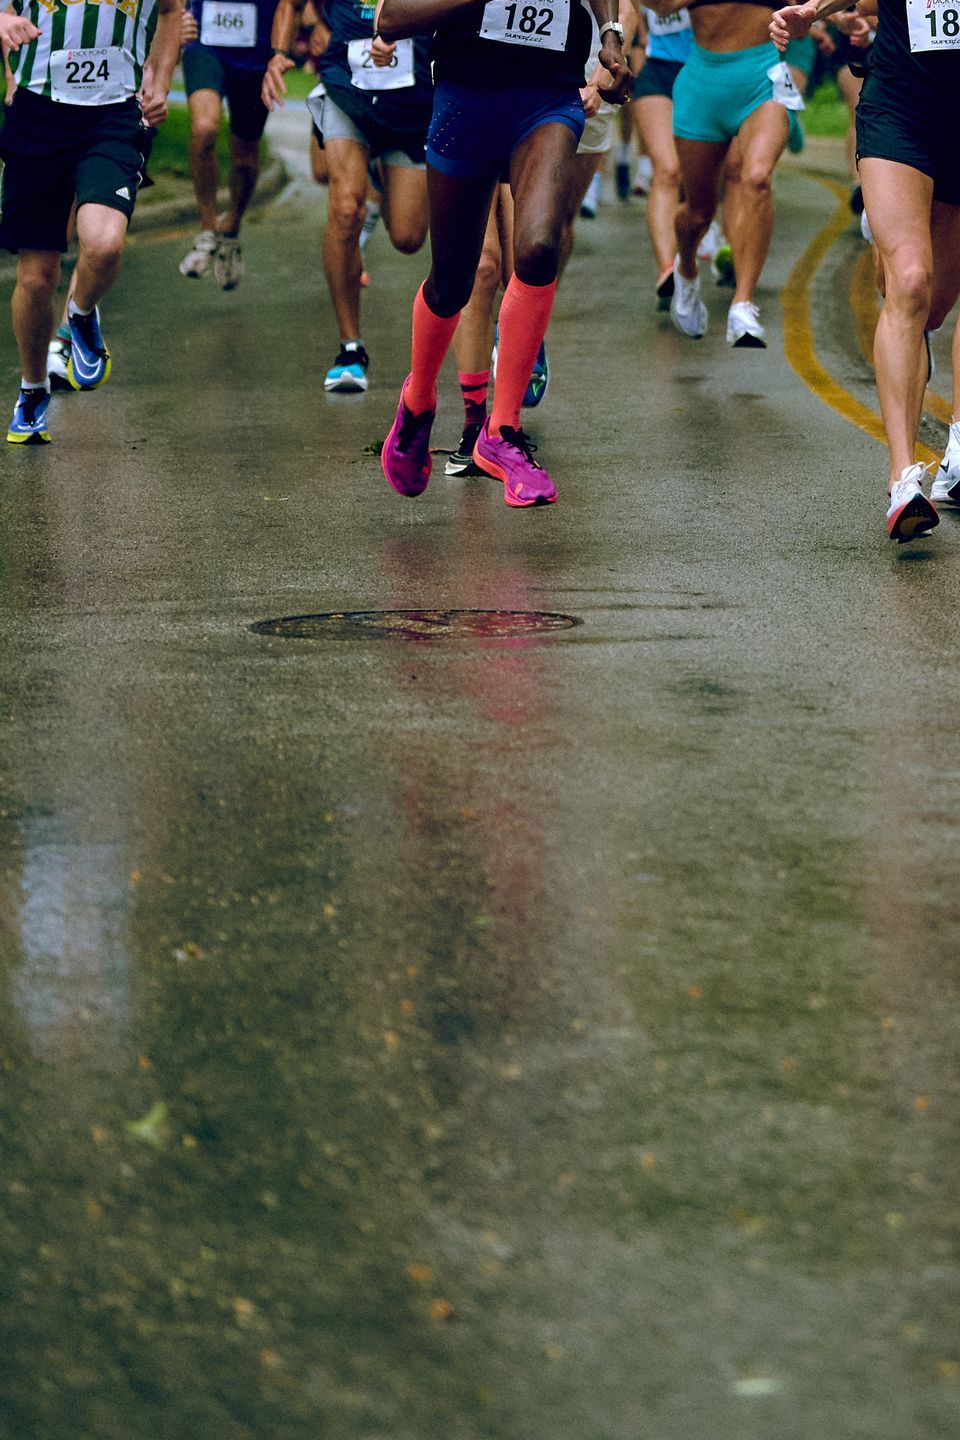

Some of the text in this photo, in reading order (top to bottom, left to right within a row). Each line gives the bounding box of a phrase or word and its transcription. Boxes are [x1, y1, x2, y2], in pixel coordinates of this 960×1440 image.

[213, 12, 244, 30] 466
[504, 3, 554, 37] 182
[65, 59, 110, 84] 224
